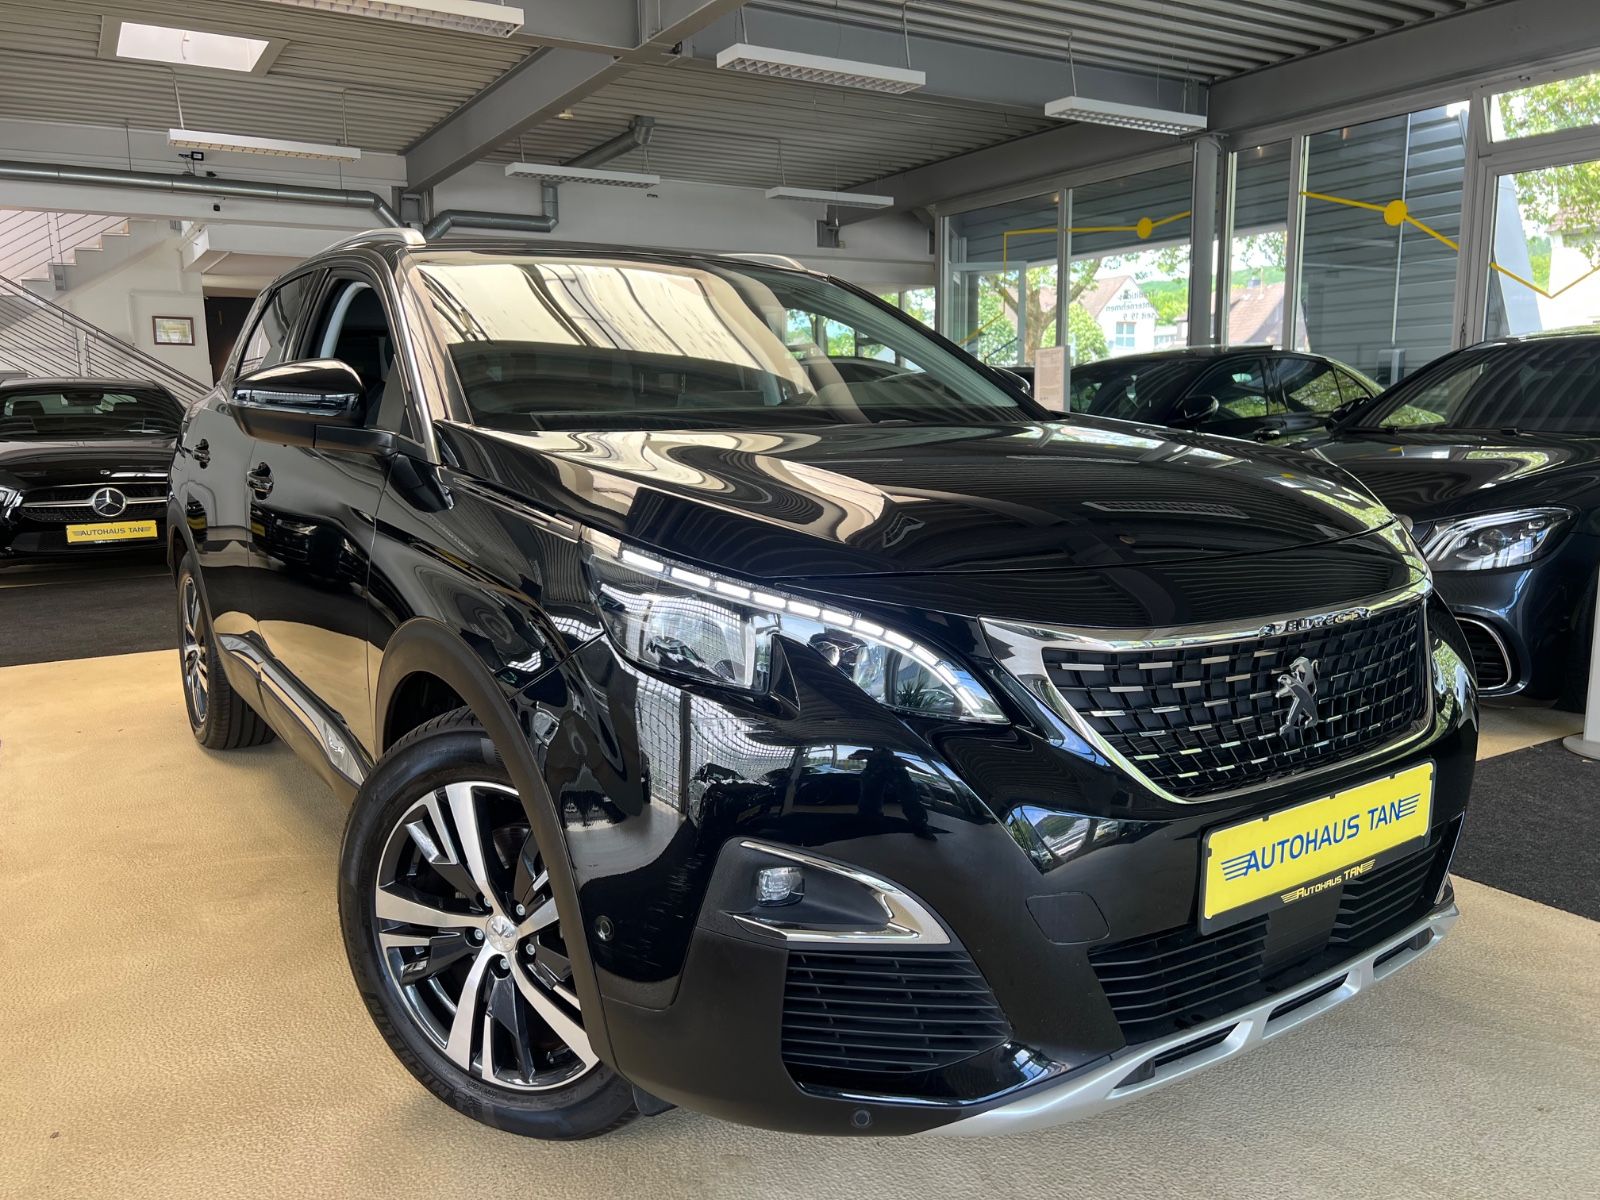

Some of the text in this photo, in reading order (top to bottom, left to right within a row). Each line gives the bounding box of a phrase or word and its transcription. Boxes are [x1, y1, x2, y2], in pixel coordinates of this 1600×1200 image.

[81, 528, 126, 536] AUTOHAUS
[1244, 799, 1401, 876] AUTOHAUS TAN
[1344, 864, 1363, 880] TAN
